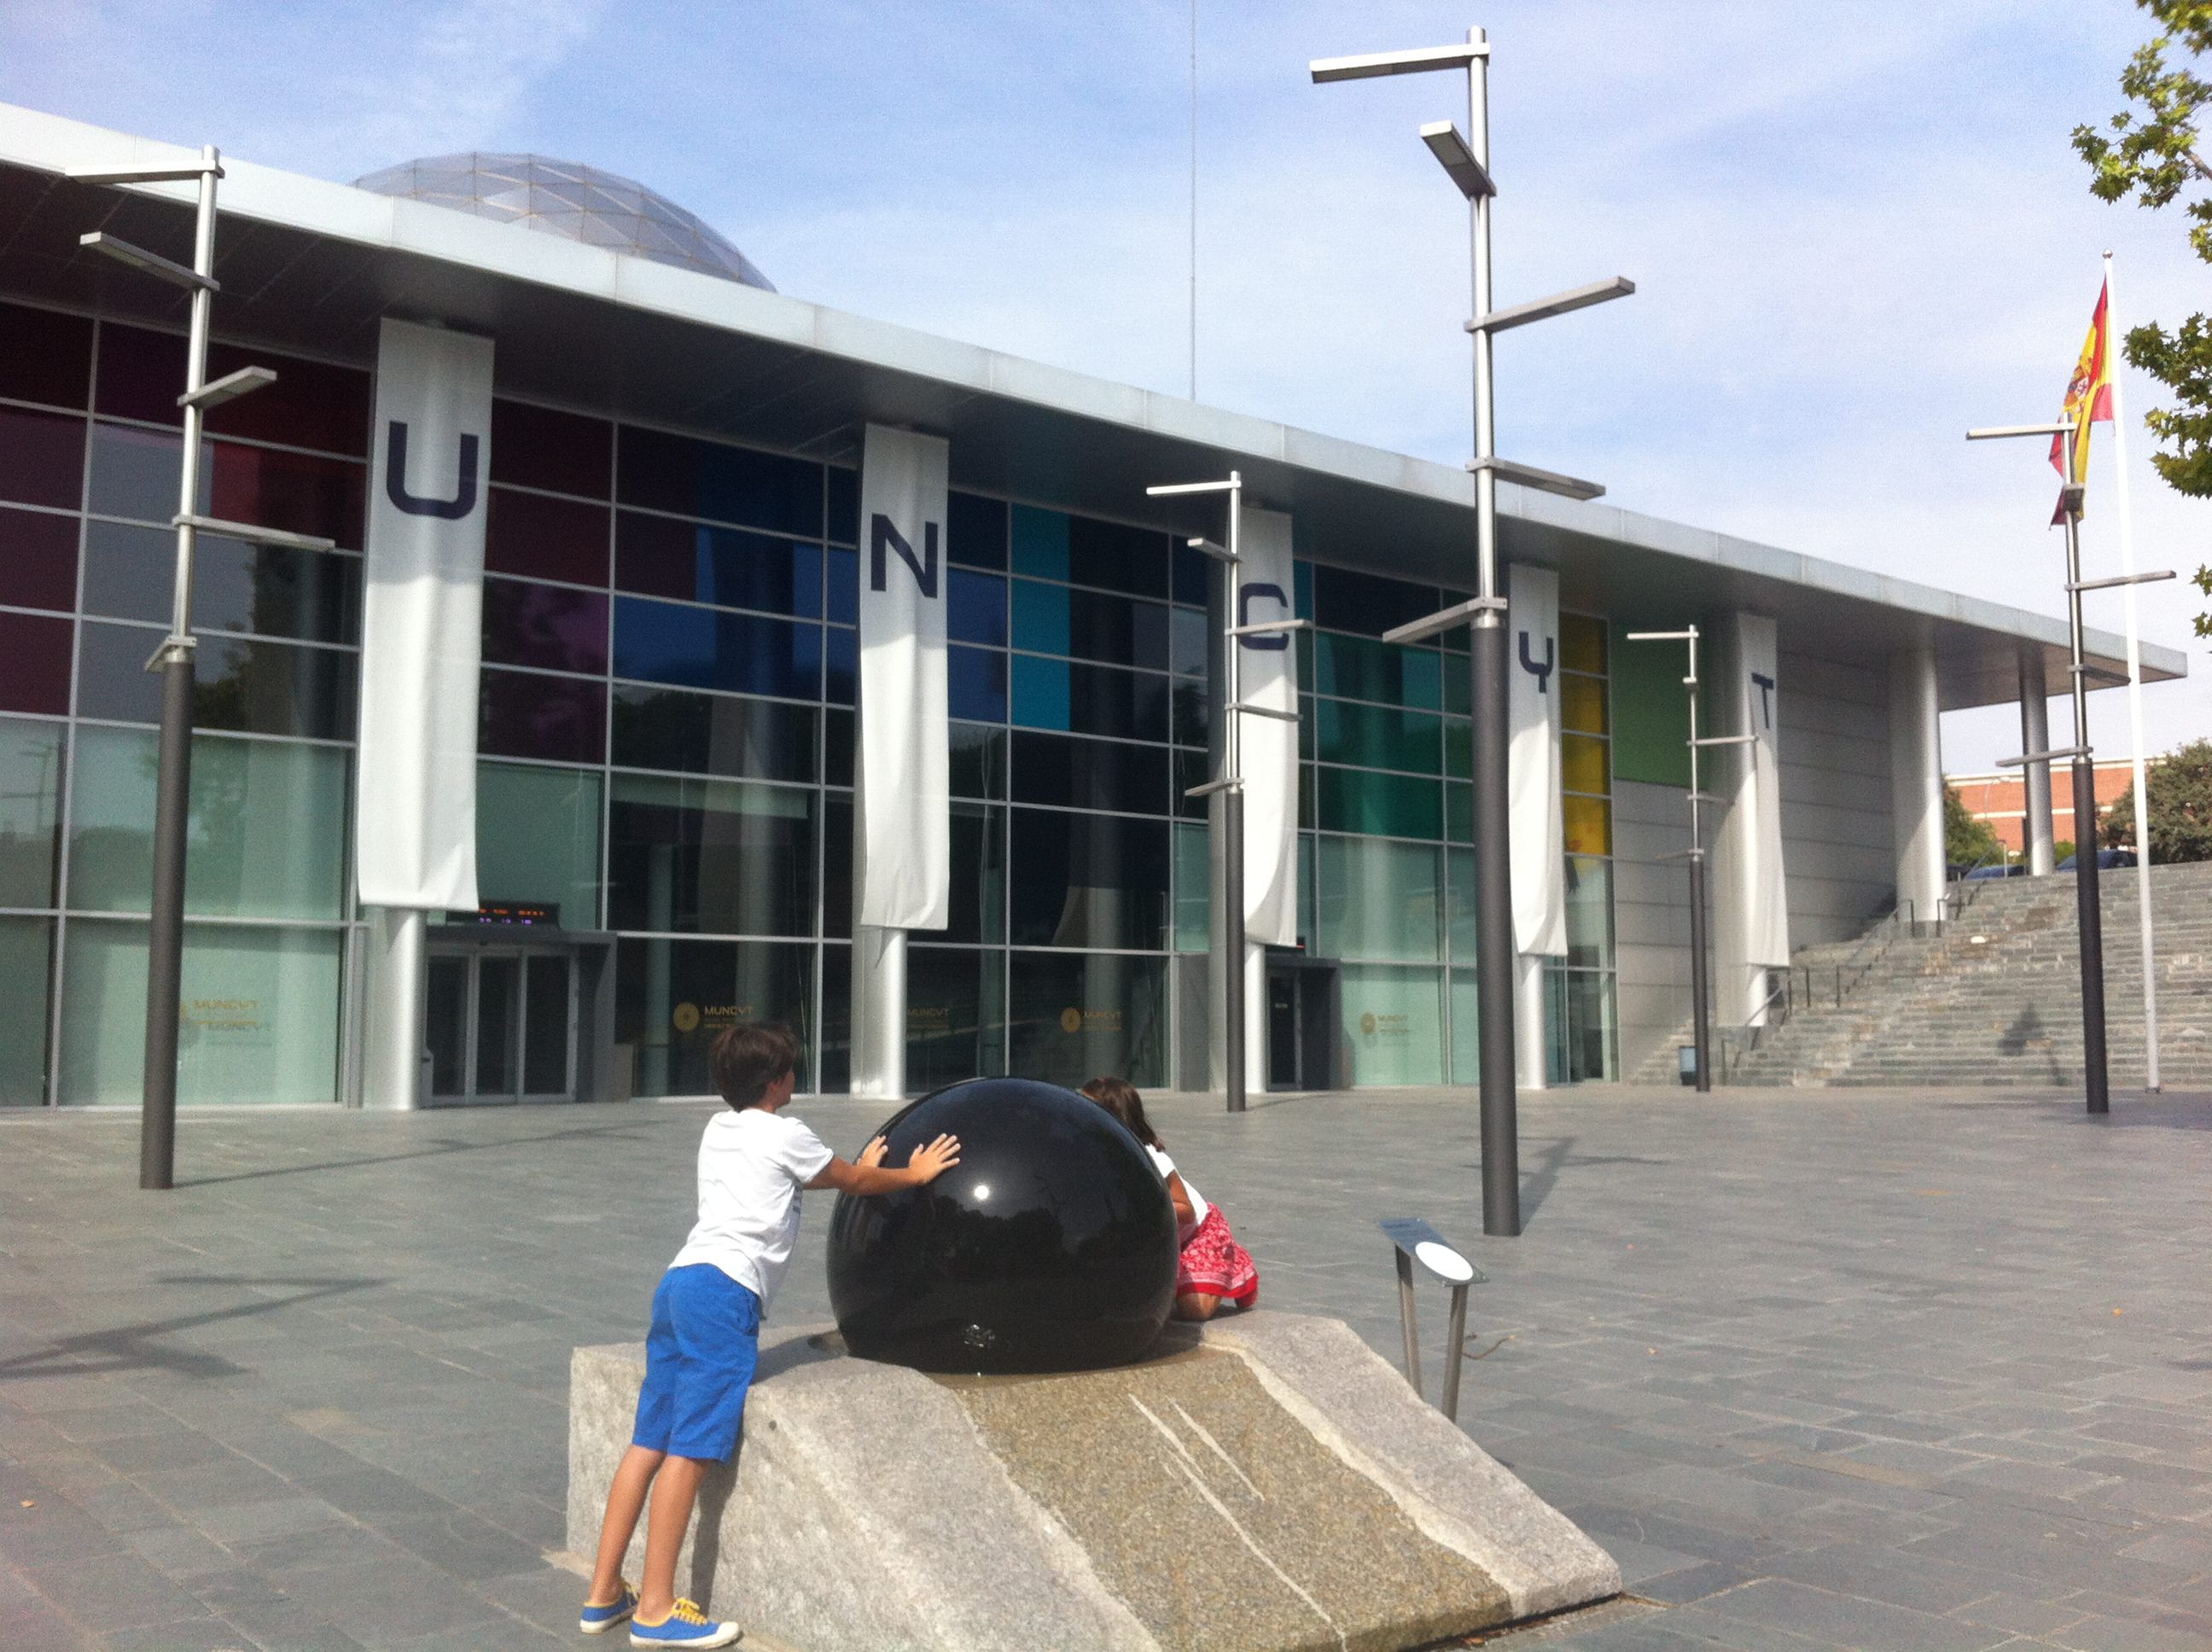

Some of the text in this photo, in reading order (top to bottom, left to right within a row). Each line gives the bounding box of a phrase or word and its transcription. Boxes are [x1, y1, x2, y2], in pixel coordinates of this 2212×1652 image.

[387, 420, 479, 520] U
[870, 514, 939, 599] N
[1239, 583, 1289, 651] C
[1519, 631, 1554, 693] Y
[1751, 672, 1774, 729] T
